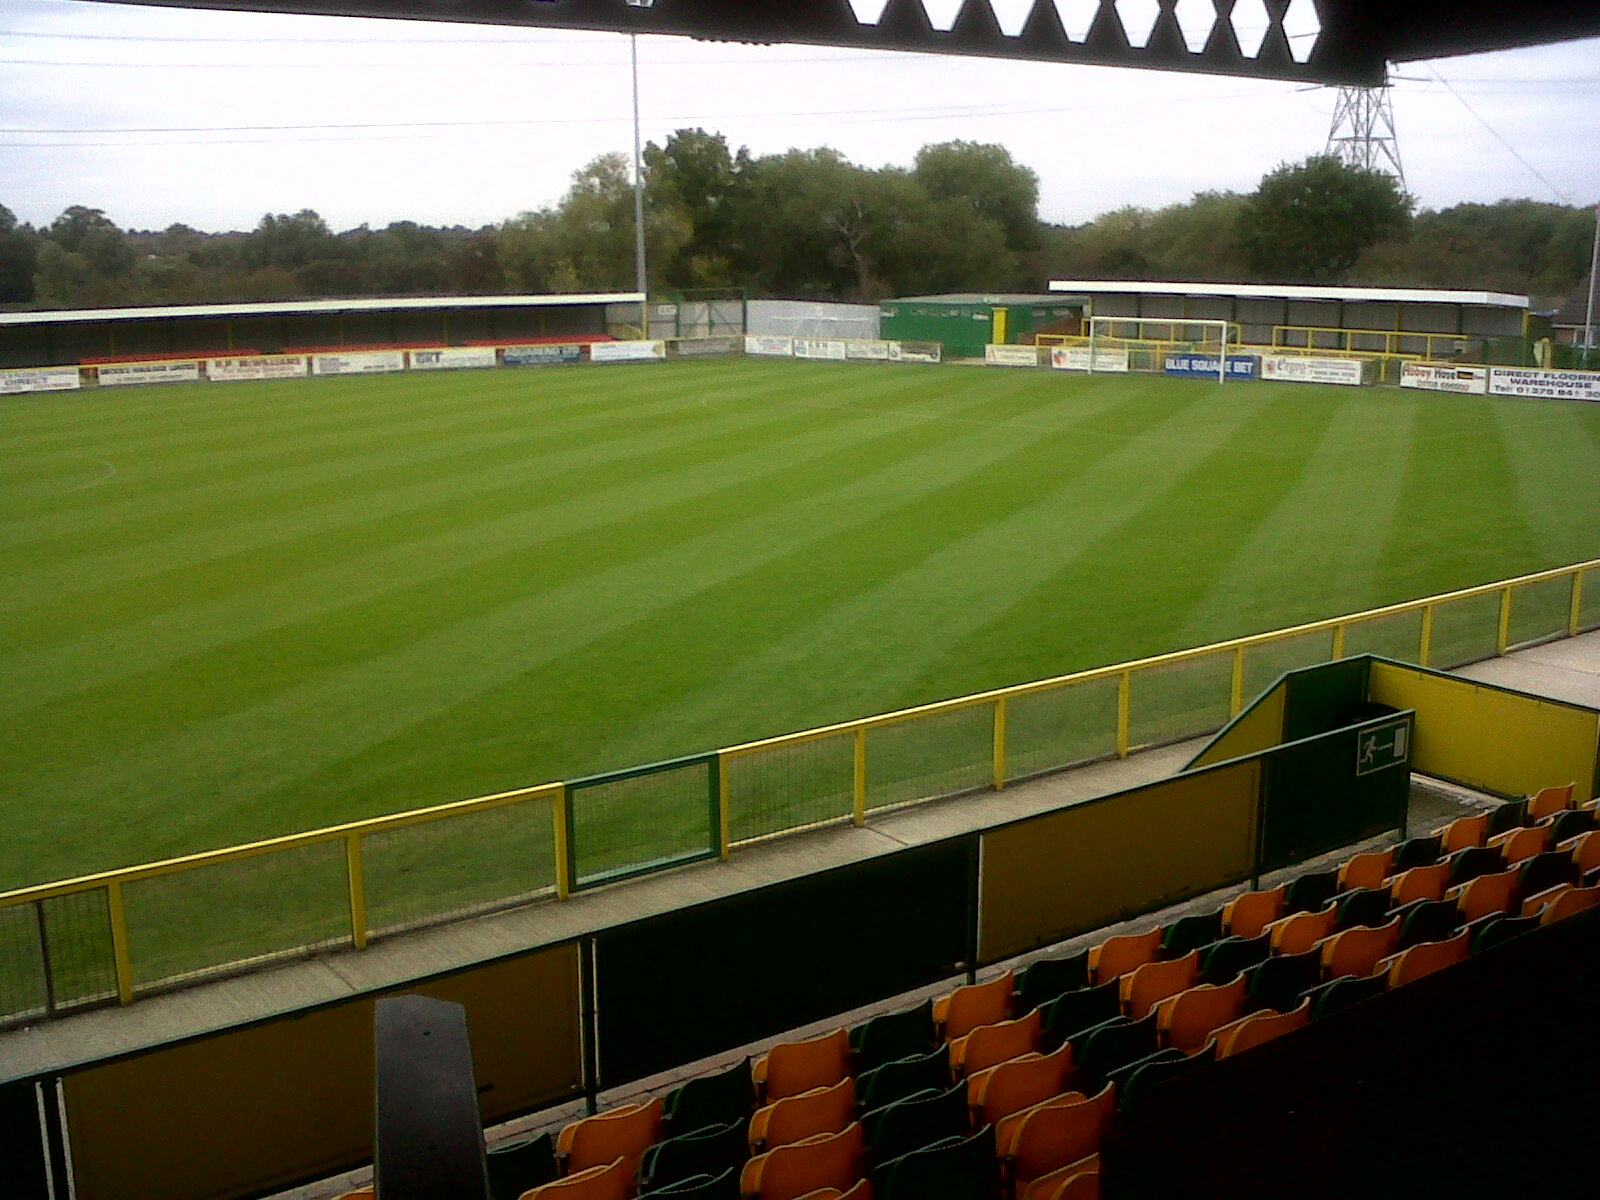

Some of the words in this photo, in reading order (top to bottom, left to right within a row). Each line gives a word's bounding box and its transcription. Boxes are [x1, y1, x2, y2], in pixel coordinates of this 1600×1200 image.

[1165, 358, 1190, 370] BLUE
[1191, 359, 1232, 373] SQUAE
[1233, 361, 1253, 373] BET
[1494, 369, 1540, 378] DIRECT
[1510, 378, 1593, 388] WAREHOUSE
